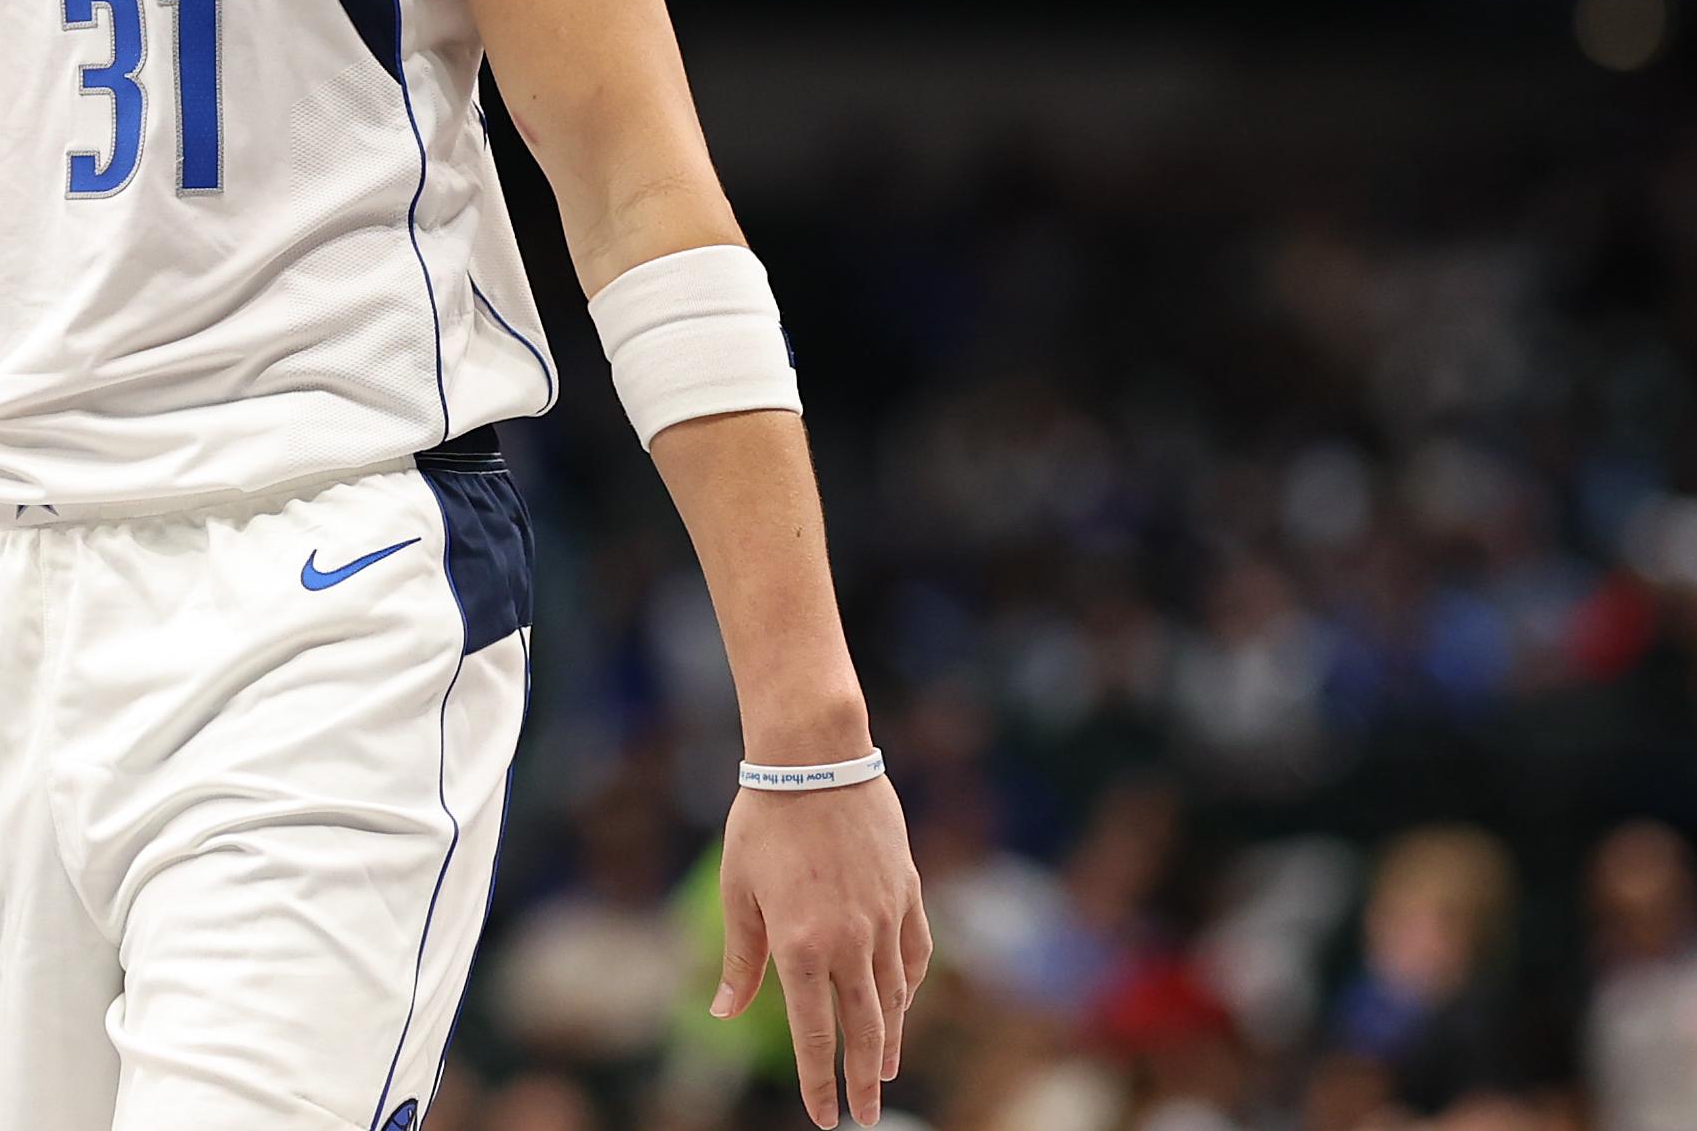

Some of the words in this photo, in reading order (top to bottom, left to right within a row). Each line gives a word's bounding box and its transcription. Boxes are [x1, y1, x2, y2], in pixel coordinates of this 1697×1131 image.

[762, 773, 778, 785] the
[781, 773, 804, 785] that
[806, 771, 835, 782] know
